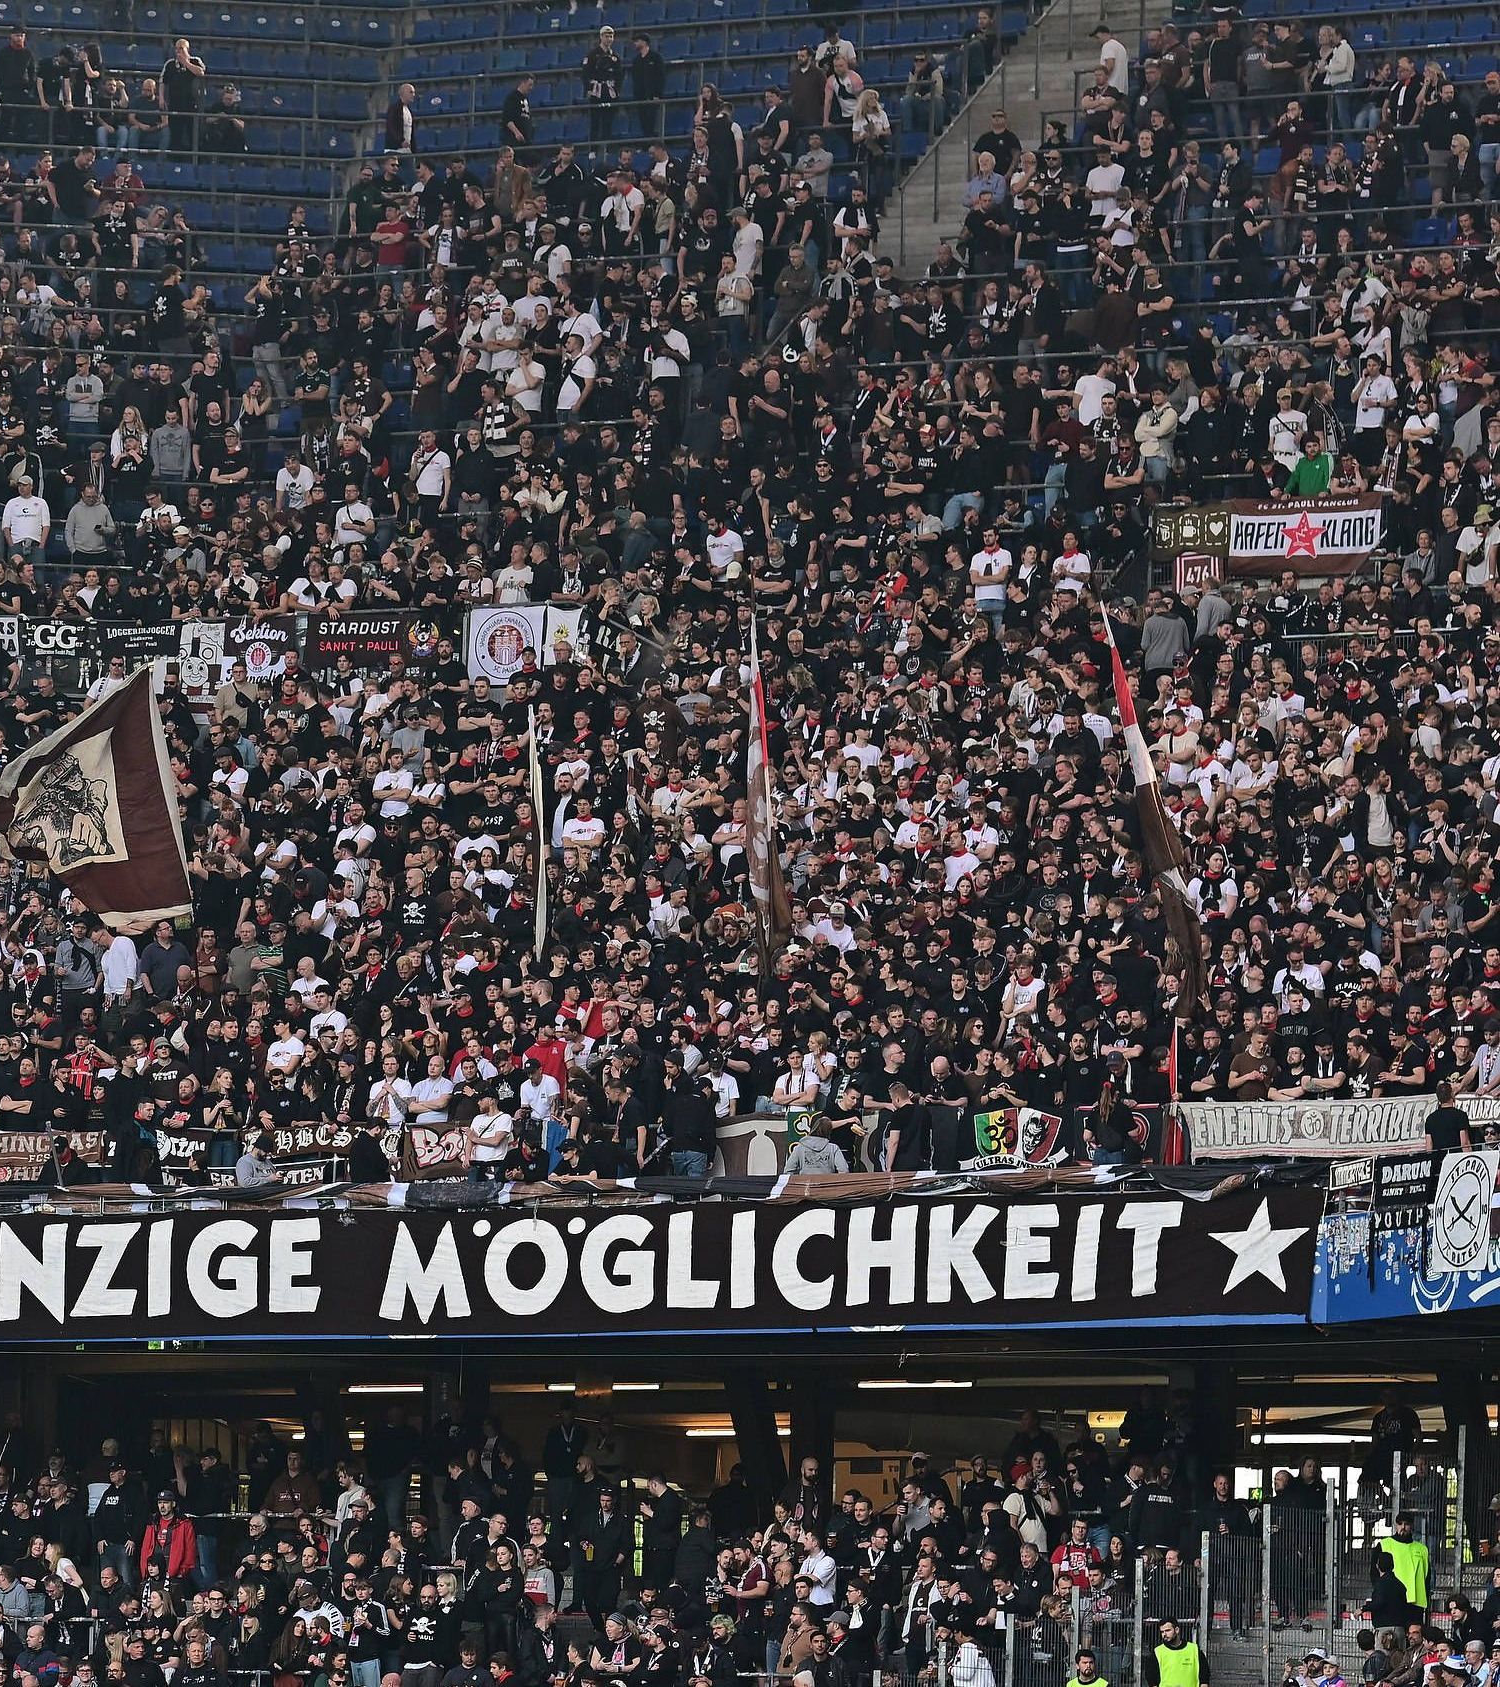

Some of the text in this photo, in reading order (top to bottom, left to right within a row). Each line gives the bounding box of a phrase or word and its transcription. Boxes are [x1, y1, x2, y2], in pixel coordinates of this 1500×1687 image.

[1287, 499, 1315, 509] PAULI
[1318, 498, 1359, 508] FANCLUB
[1233, 515, 1376, 551] HAFEN KLANG
[230, 614, 288, 643] Sektion
[319, 620, 400, 635] STARDUST
[319, 640, 399, 652] SANKT PAULI
[1190, 1106, 1297, 1148] ENFANTS
[975, 1156, 1015, 1169] ULTRAS
[1381, 1160, 1432, 1184] DARUM
[1375, 1208, 1424, 1229] YOUTH
[378, 1201, 1184, 1325] MÖGLICHKEIT
